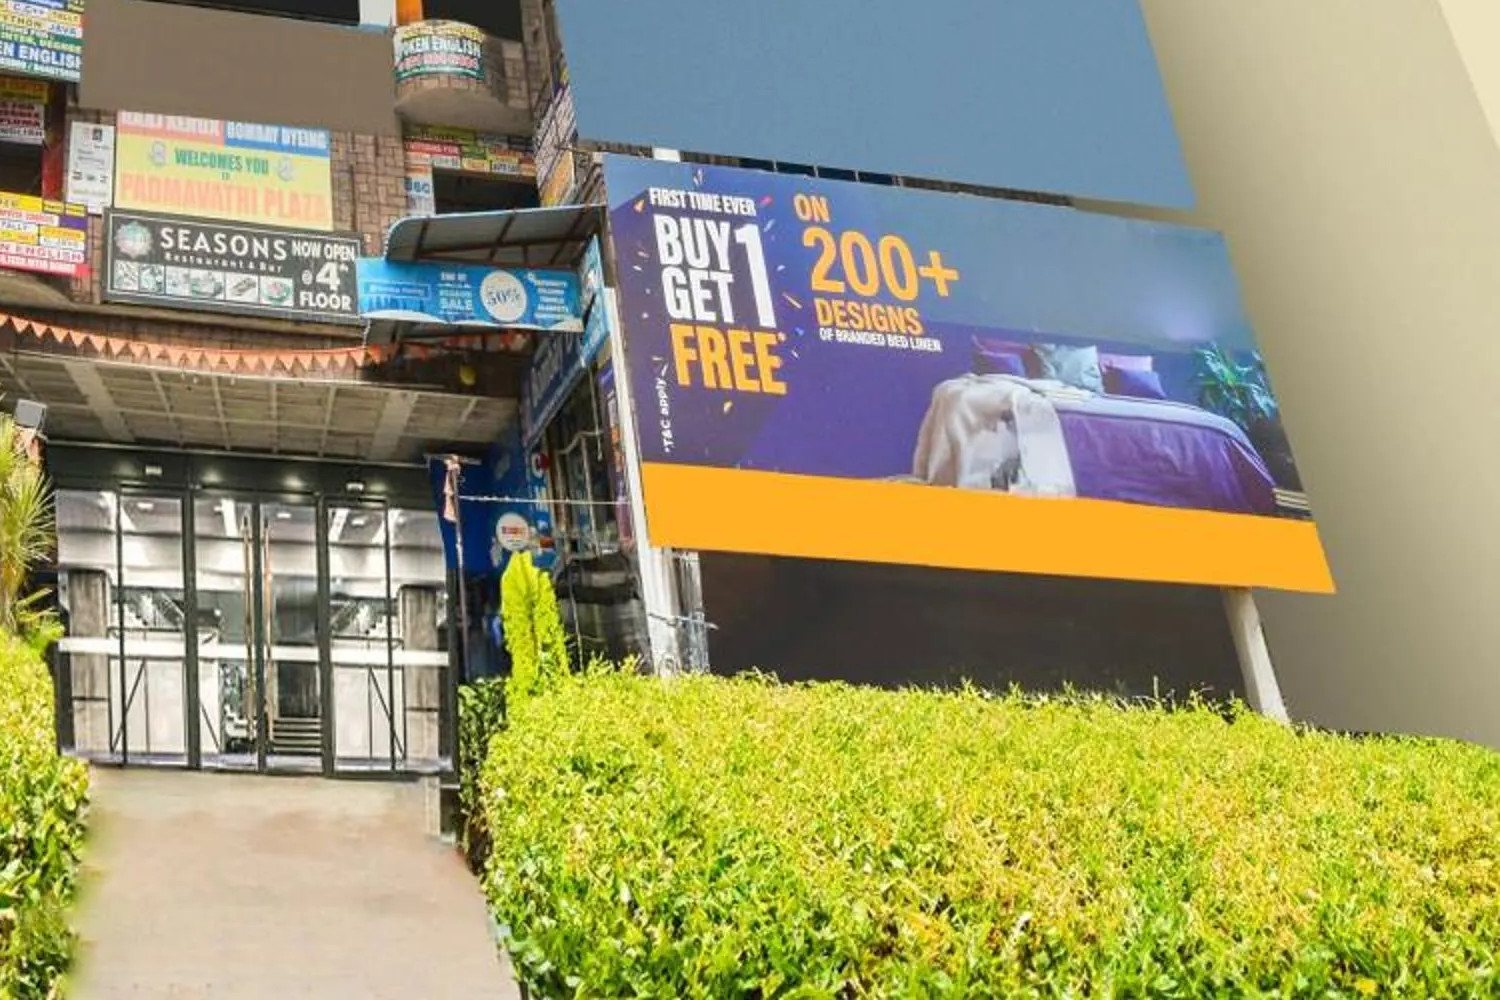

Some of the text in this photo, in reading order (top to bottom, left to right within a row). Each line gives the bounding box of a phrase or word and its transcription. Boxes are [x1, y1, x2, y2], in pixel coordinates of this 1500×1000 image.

[431, 35, 482, 58] ENGLISH
[174, 147, 270, 175] WELCOMES YOU
[120, 172, 327, 222] PADMAVATHI PLAZA
[649, 187, 757, 217] FIRST TIME EVER
[793, 192, 831, 223] ON
[15, 245, 84, 262] ENGLISH
[160, 227, 287, 261] SEASONS
[291, 239, 357, 262] NOW OPEN
[164, 252, 245, 270] Restaurant
[260, 261, 283, 274] Bar
[301, 270, 313, 285] @
[653, 213, 777, 329] BUY 1
[802, 226, 959, 301] 200+
[300, 290, 351, 310] FLOOR
[661, 266, 735, 324] GET
[813, 297, 925, 335] DESIGNS
[818, 327, 835, 341] OF
[835, 329, 886, 347] BRANDED
[887, 333, 909, 349] BED
